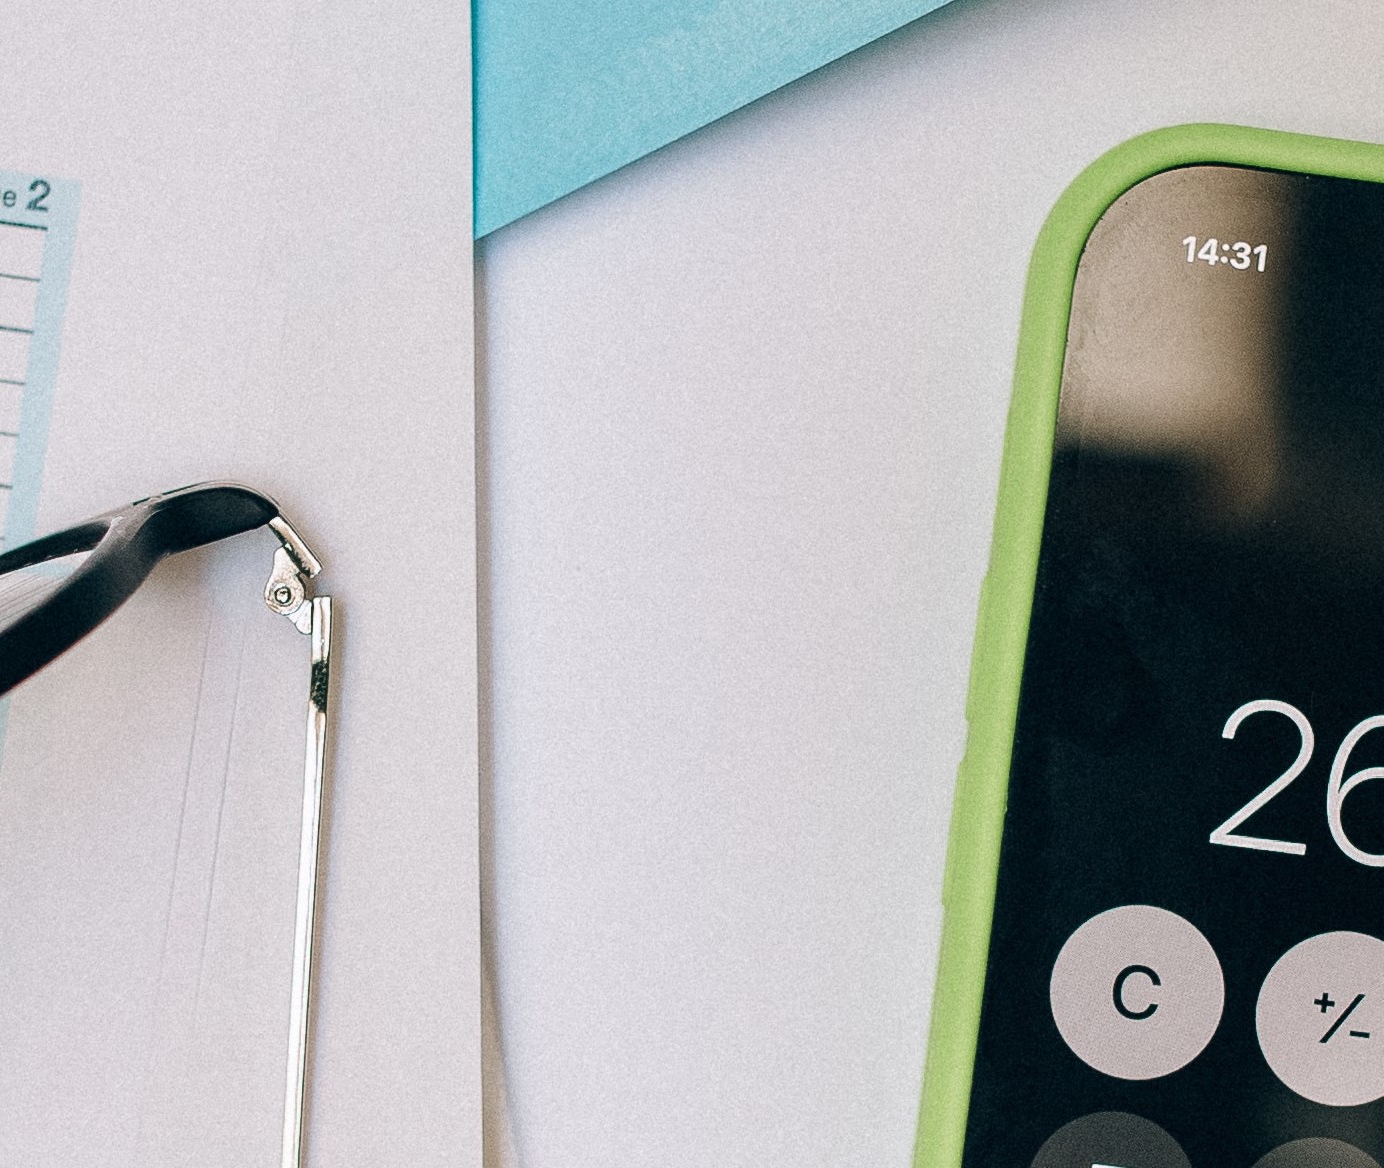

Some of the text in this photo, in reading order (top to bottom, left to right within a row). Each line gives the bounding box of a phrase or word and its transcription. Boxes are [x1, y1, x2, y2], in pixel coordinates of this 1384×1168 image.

[25, 178, 52, 213] 2
[1182, 234, 1268, 275] 14:31
[1112, 964, 1161, 1021] C
